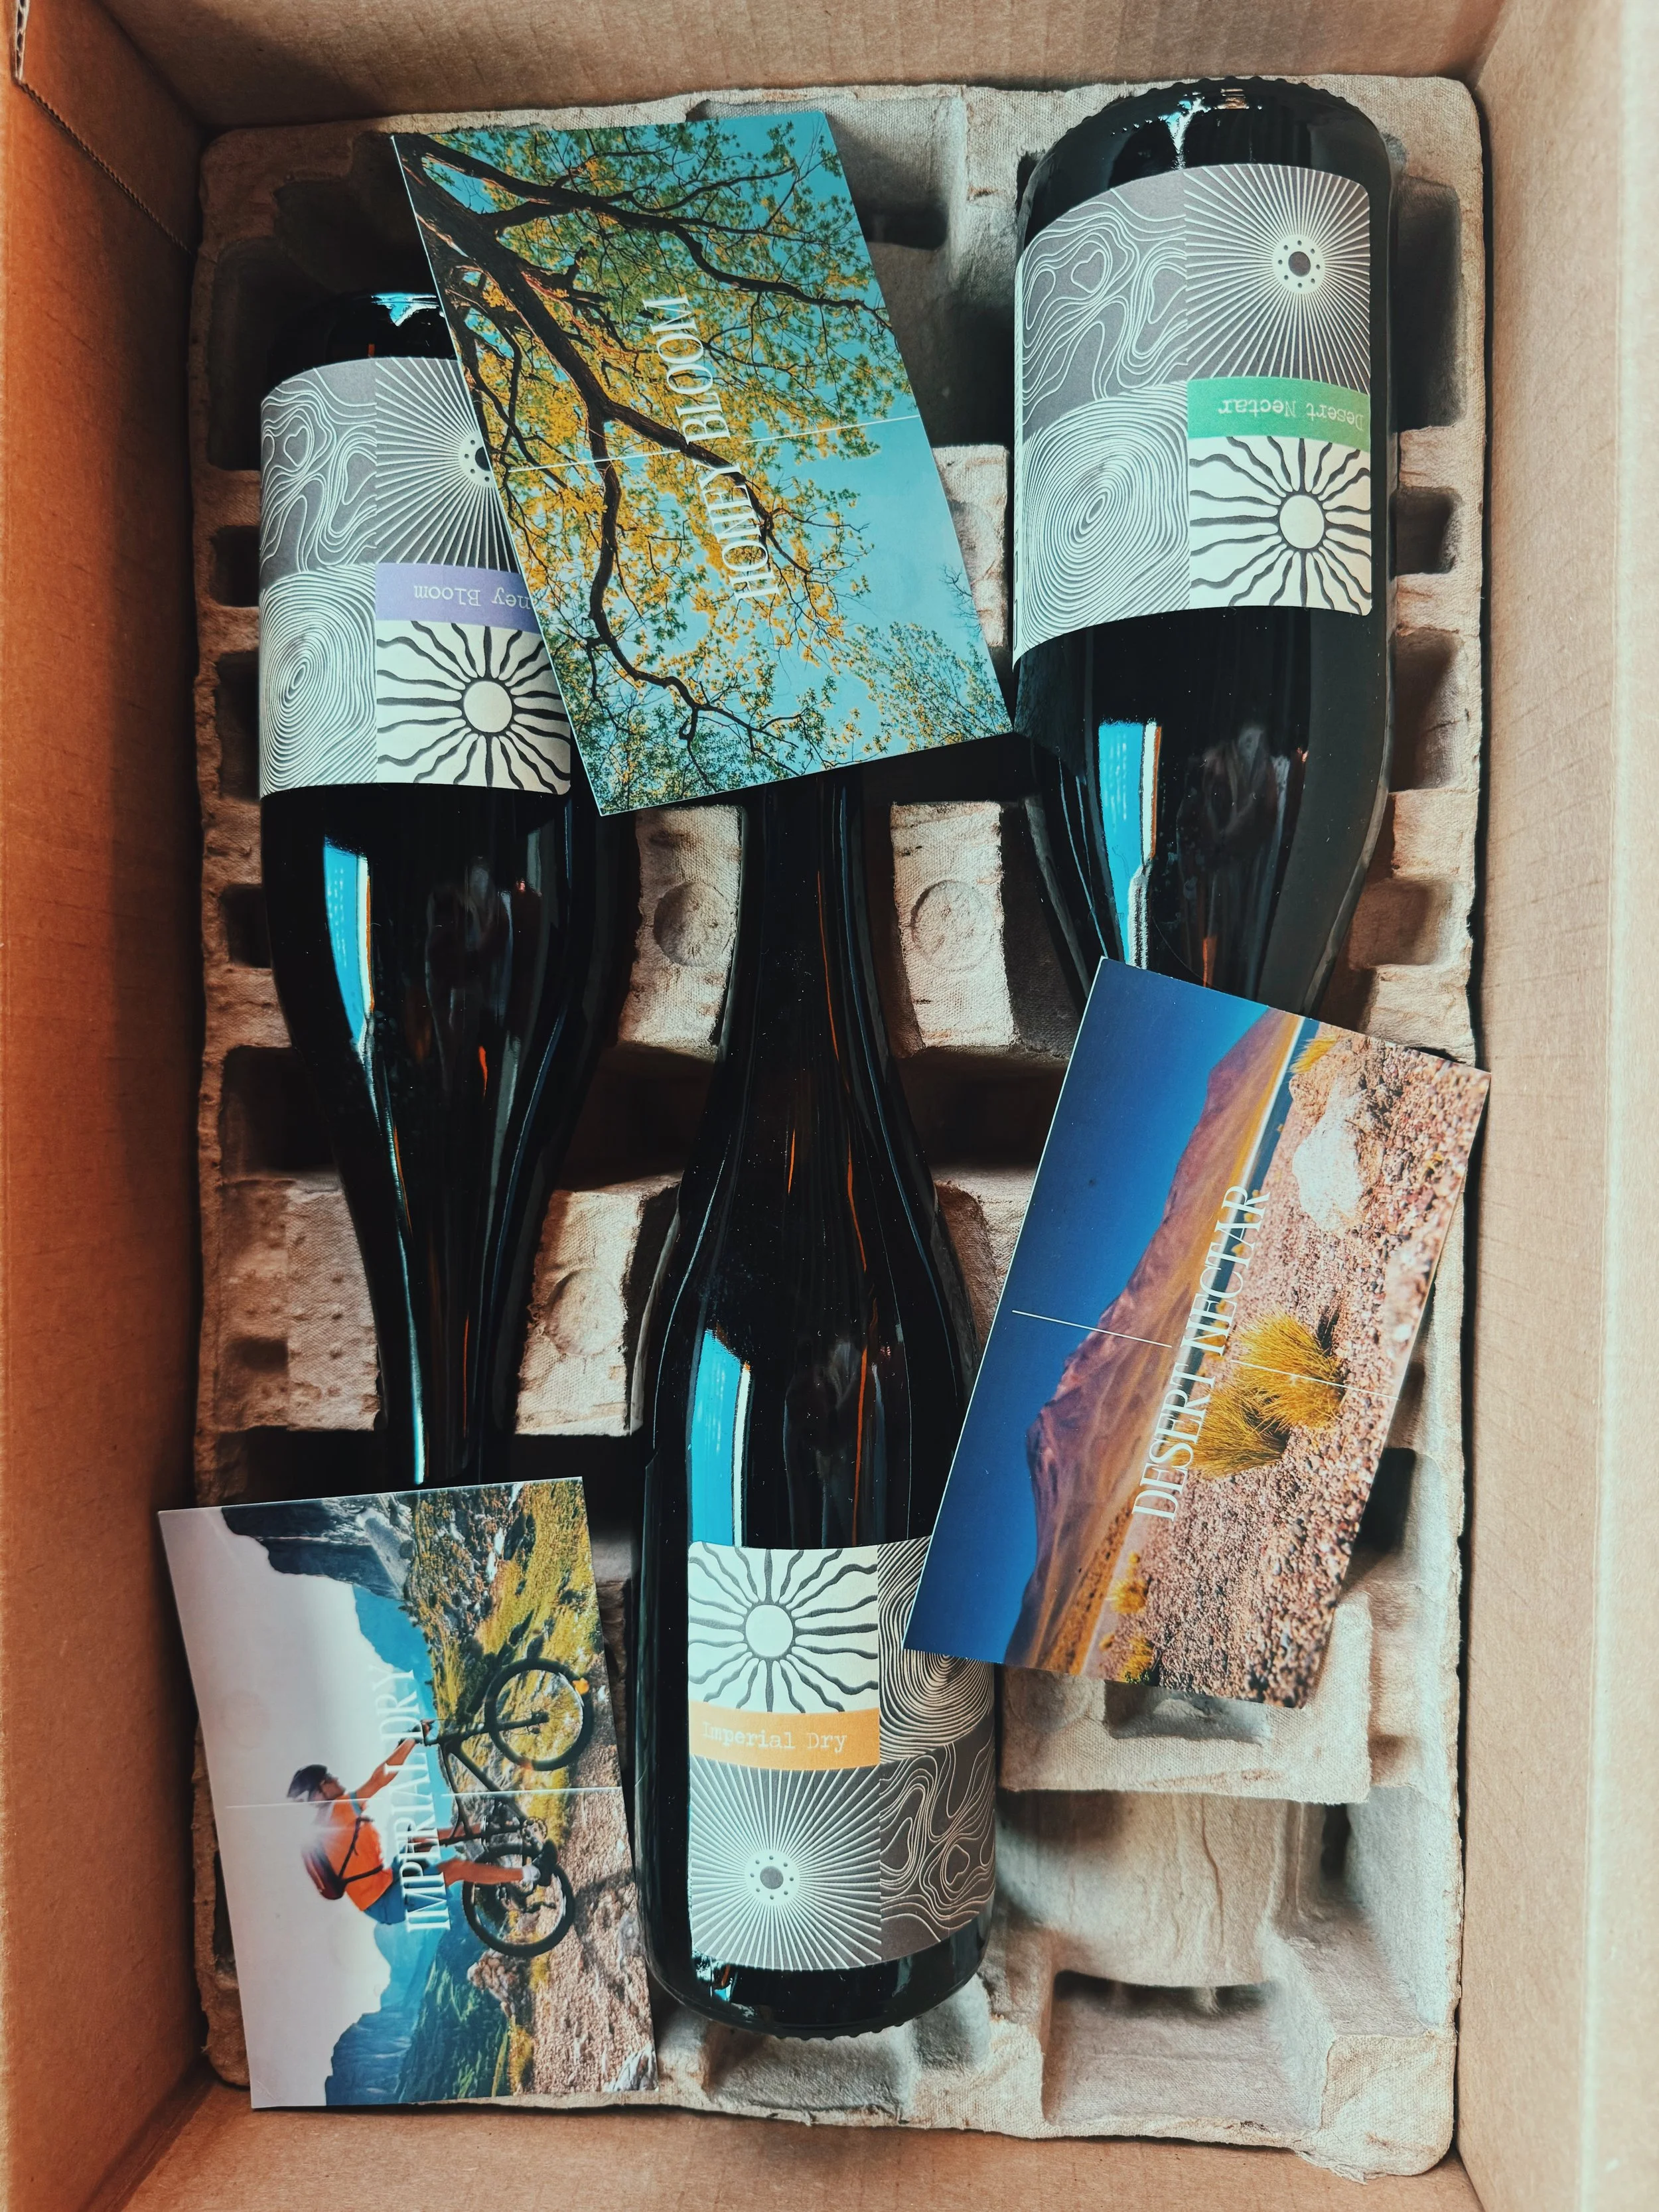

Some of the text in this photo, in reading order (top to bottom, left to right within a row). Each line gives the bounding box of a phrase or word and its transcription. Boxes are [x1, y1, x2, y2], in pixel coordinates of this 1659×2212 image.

[642, 295, 781, 601] HONEY BLOOM
[1218, 398, 1364, 431] Desert Nectar
[413, 585, 531, 610] ney Bloom
[1131, 1185, 1271, 1521] DESERT NECTAR
[370, 1664, 451, 1932] IMPERIAL DRY
[701, 1722, 847, 1753] Imperial Dry
